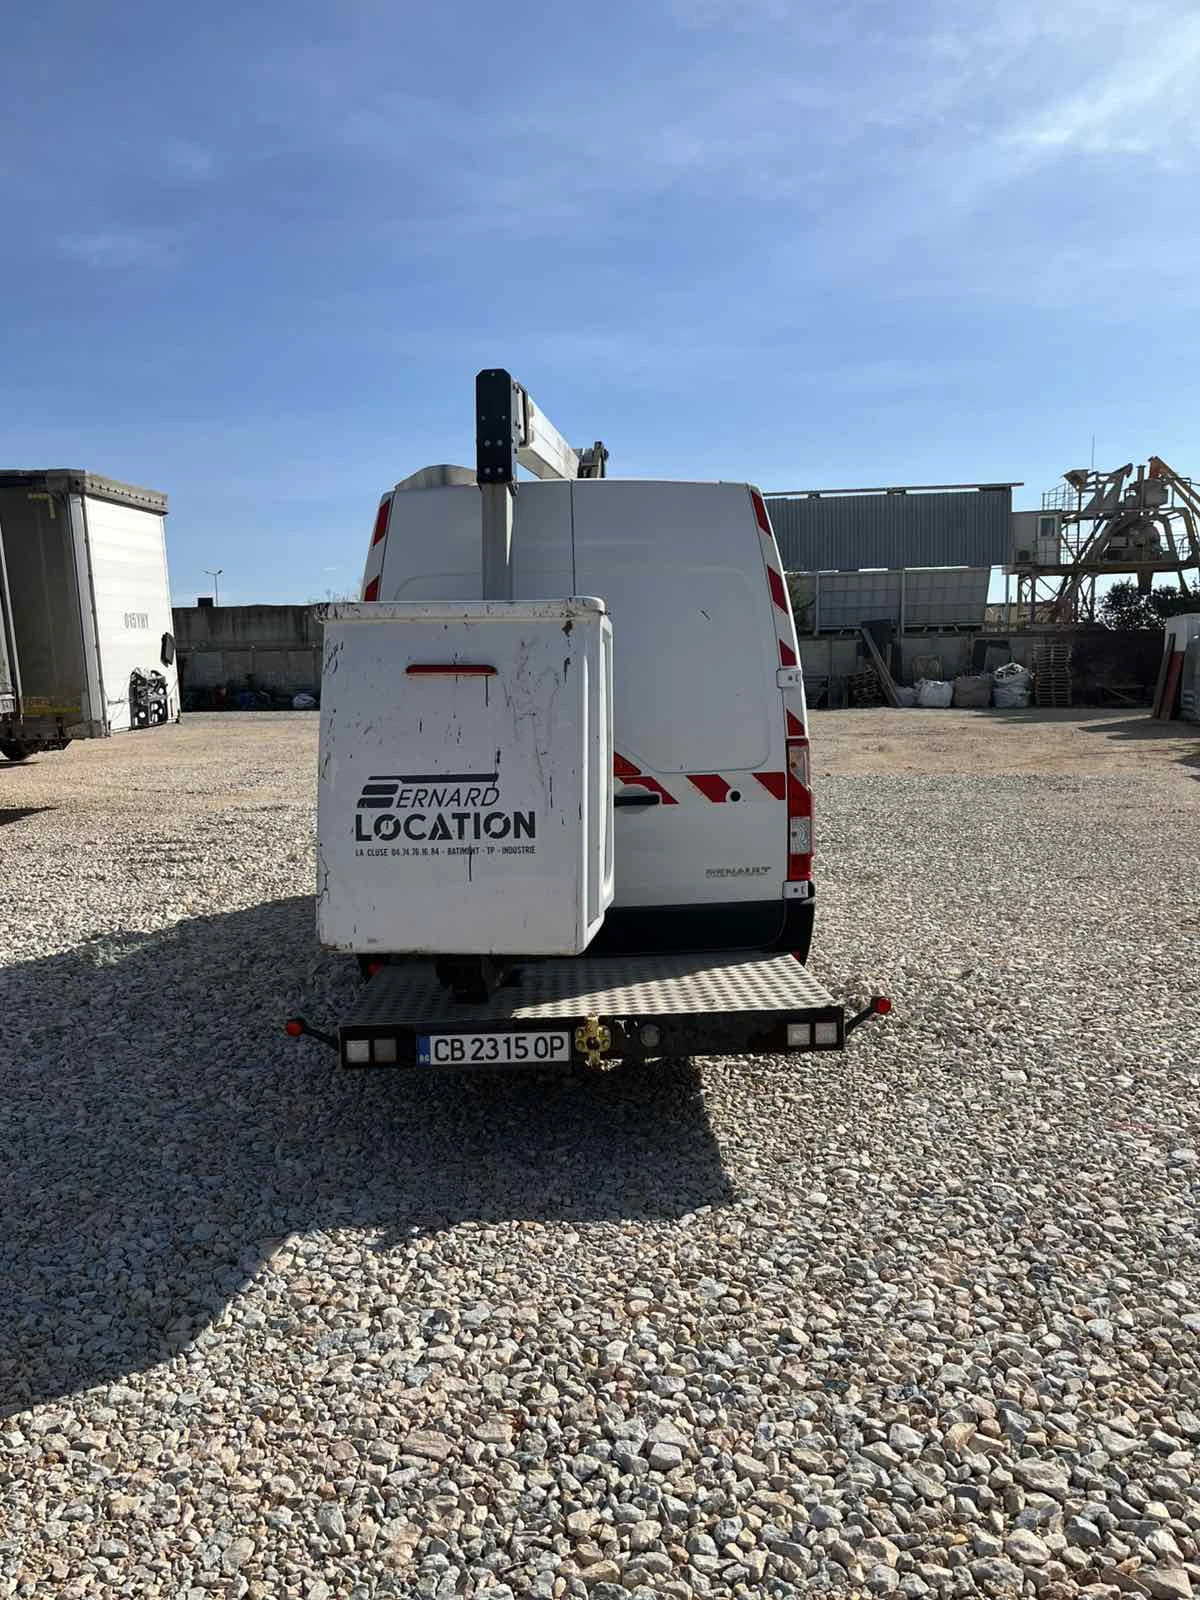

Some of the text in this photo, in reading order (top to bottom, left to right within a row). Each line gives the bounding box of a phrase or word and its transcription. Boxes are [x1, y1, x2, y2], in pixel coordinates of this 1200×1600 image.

[357, 774, 500, 808] BERNARD
[355, 811, 536, 842] LOCATION
[355, 848, 364, 856] LA
[434, 1038, 465, 1062] CB
[470, 1037, 529, 1061] 2315
